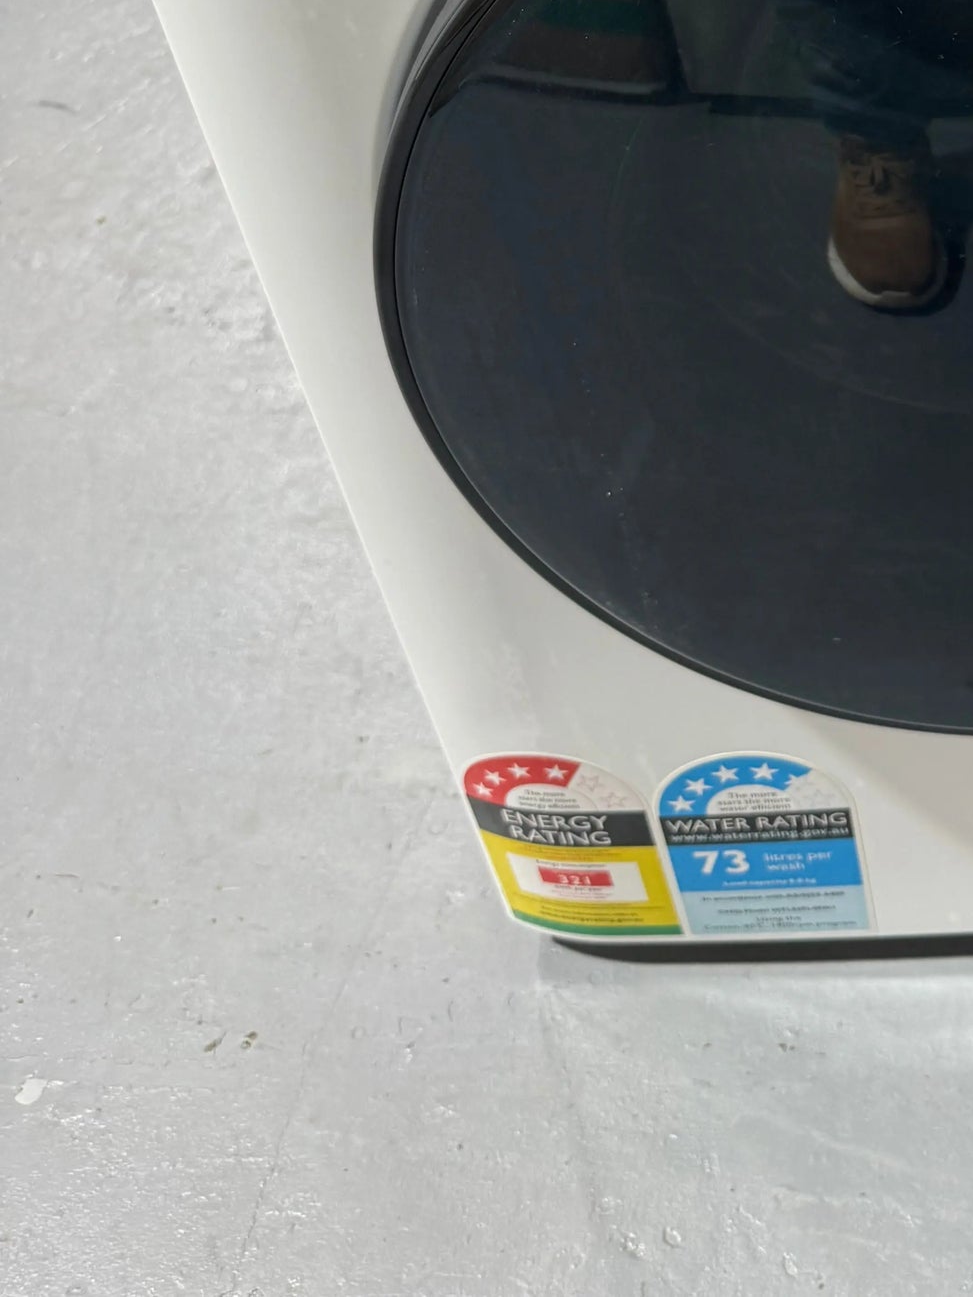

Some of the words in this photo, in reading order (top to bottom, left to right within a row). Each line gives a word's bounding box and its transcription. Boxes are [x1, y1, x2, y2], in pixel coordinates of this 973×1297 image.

[502, 808, 607, 830] ENERGY
[666, 817, 750, 833] WATER
[755, 812, 848, 831] RATING
[511, 826, 611, 846] RATING
[672, 827, 849, 842] www.waterrating.gov.au
[693, 849, 750, 875] 73
[767, 862, 805, 871] wash
[807, 851, 832, 862] per
